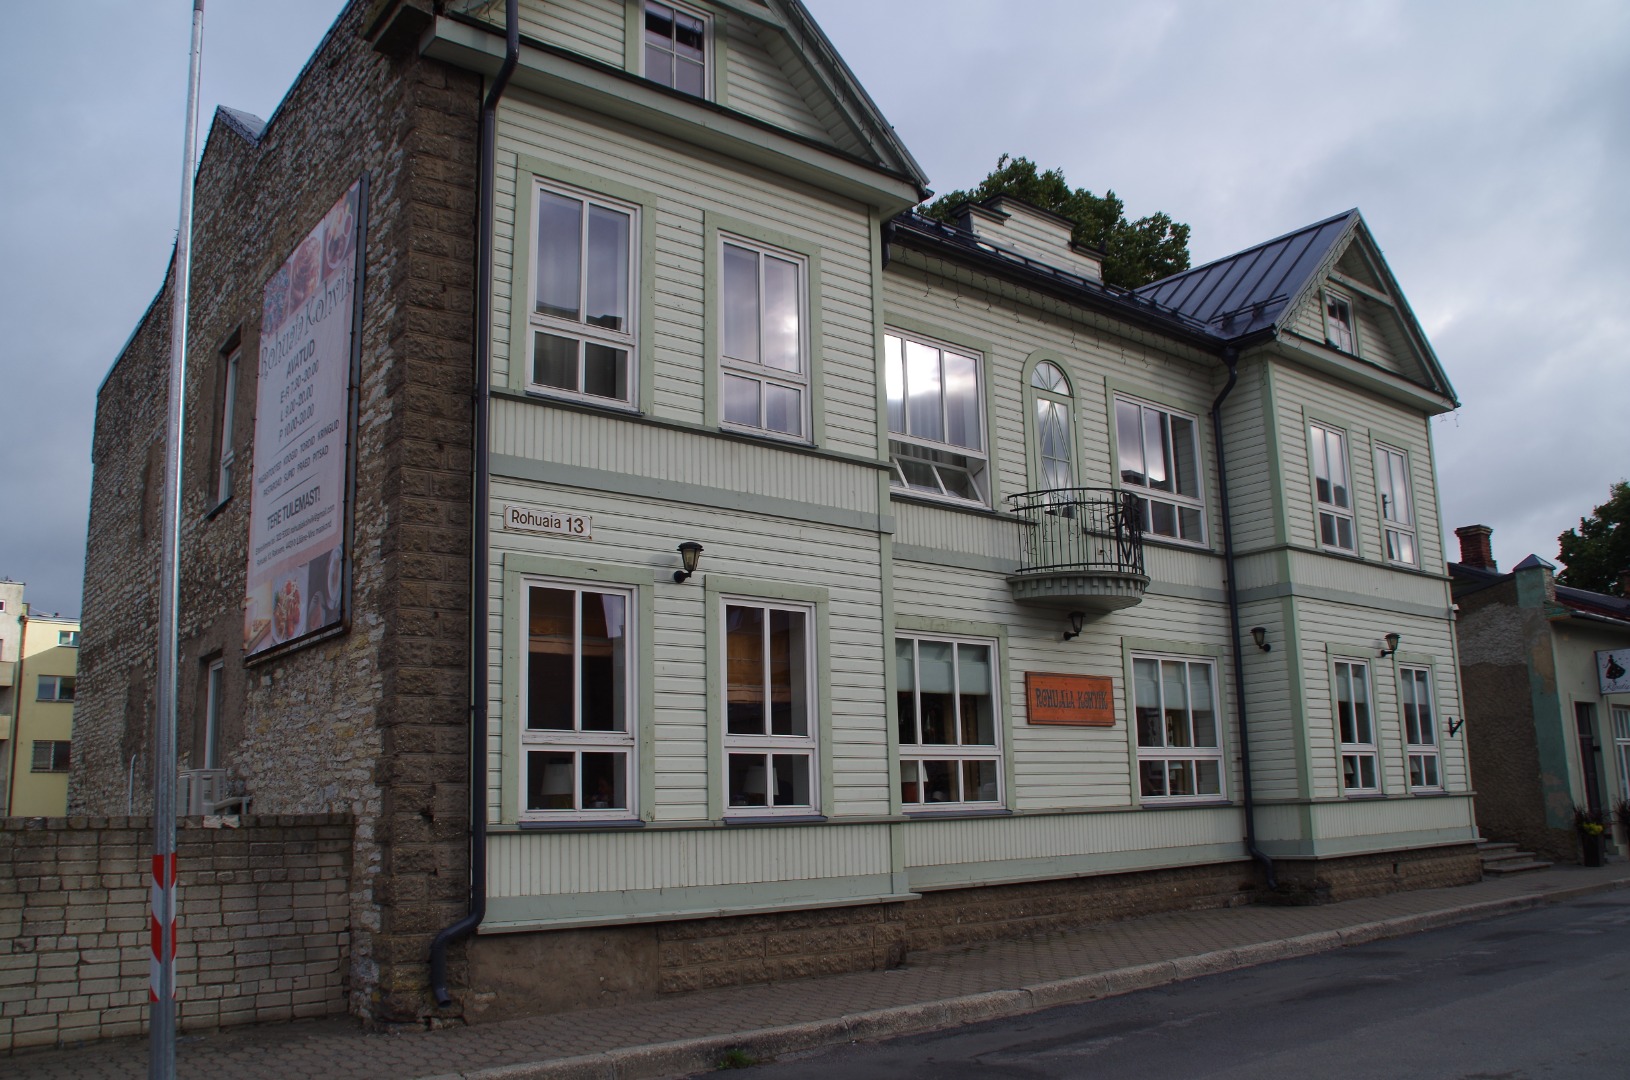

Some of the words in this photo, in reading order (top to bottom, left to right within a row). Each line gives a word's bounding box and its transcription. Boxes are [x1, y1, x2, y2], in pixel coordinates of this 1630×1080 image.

[260, 312, 303, 380] Rohuaia
[304, 257, 354, 334] Kohvik
[286, 339, 315, 379] AVATUD
[312, 444, 329, 463] PITSAD
[267, 508, 282, 531] TERE
[282, 485, 320, 521] TULEMAST!
[511, 509, 561, 529] Rohuaia
[566, 517, 584, 534] 13
